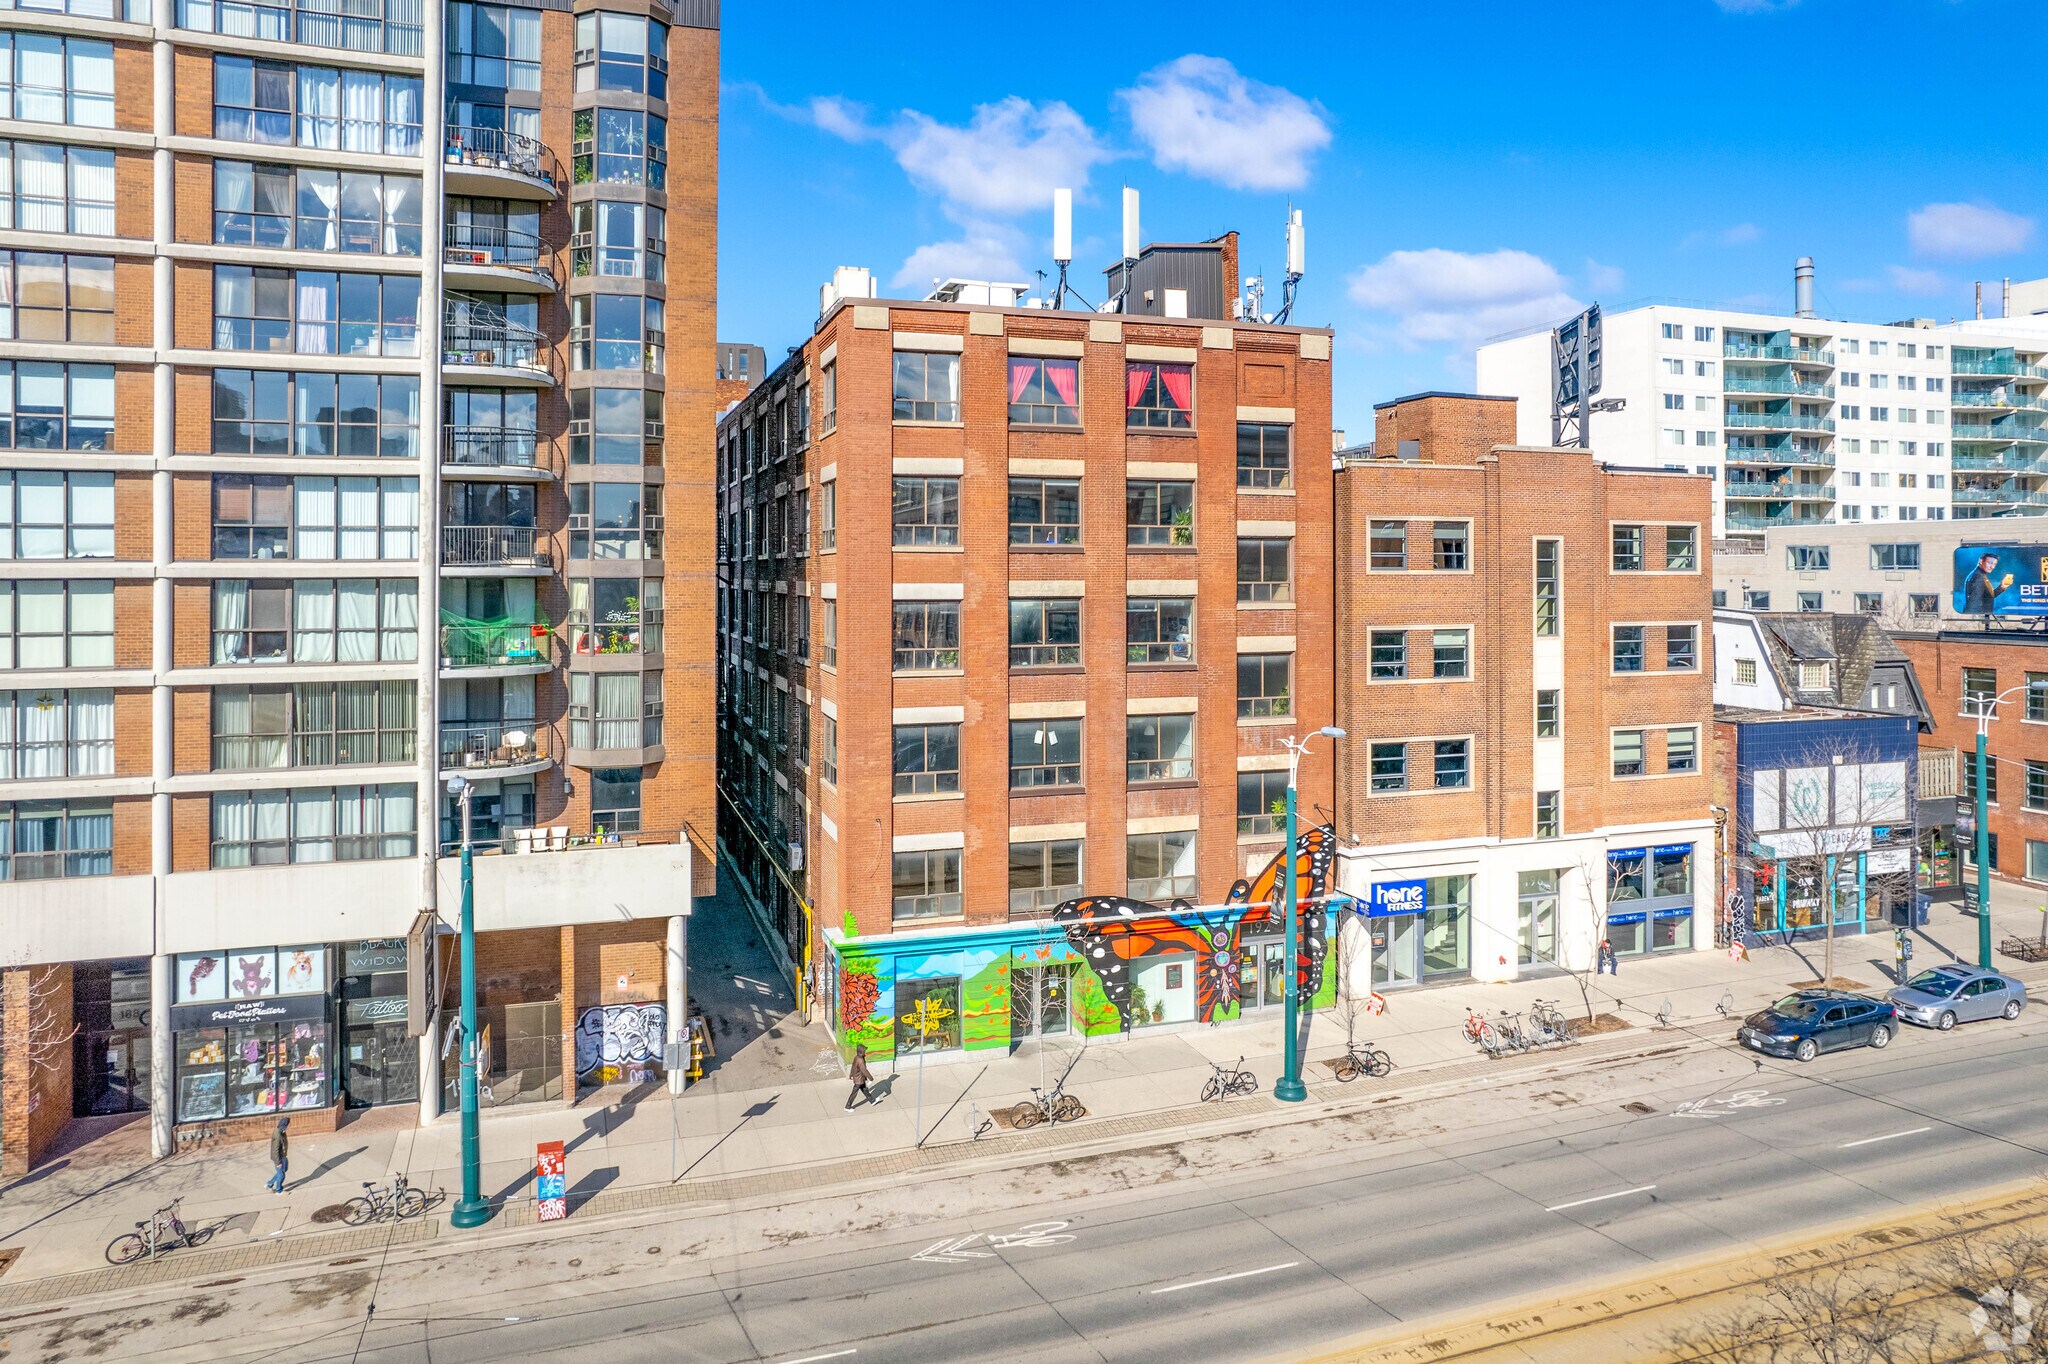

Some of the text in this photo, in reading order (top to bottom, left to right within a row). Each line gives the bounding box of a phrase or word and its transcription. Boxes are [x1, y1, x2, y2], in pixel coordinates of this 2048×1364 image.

[1376, 885, 1423, 904] hone
[1387, 901, 1423, 912] FITNESS
[1249, 921, 1270, 933] 192
[355, 1000, 408, 1017] Tattoo
